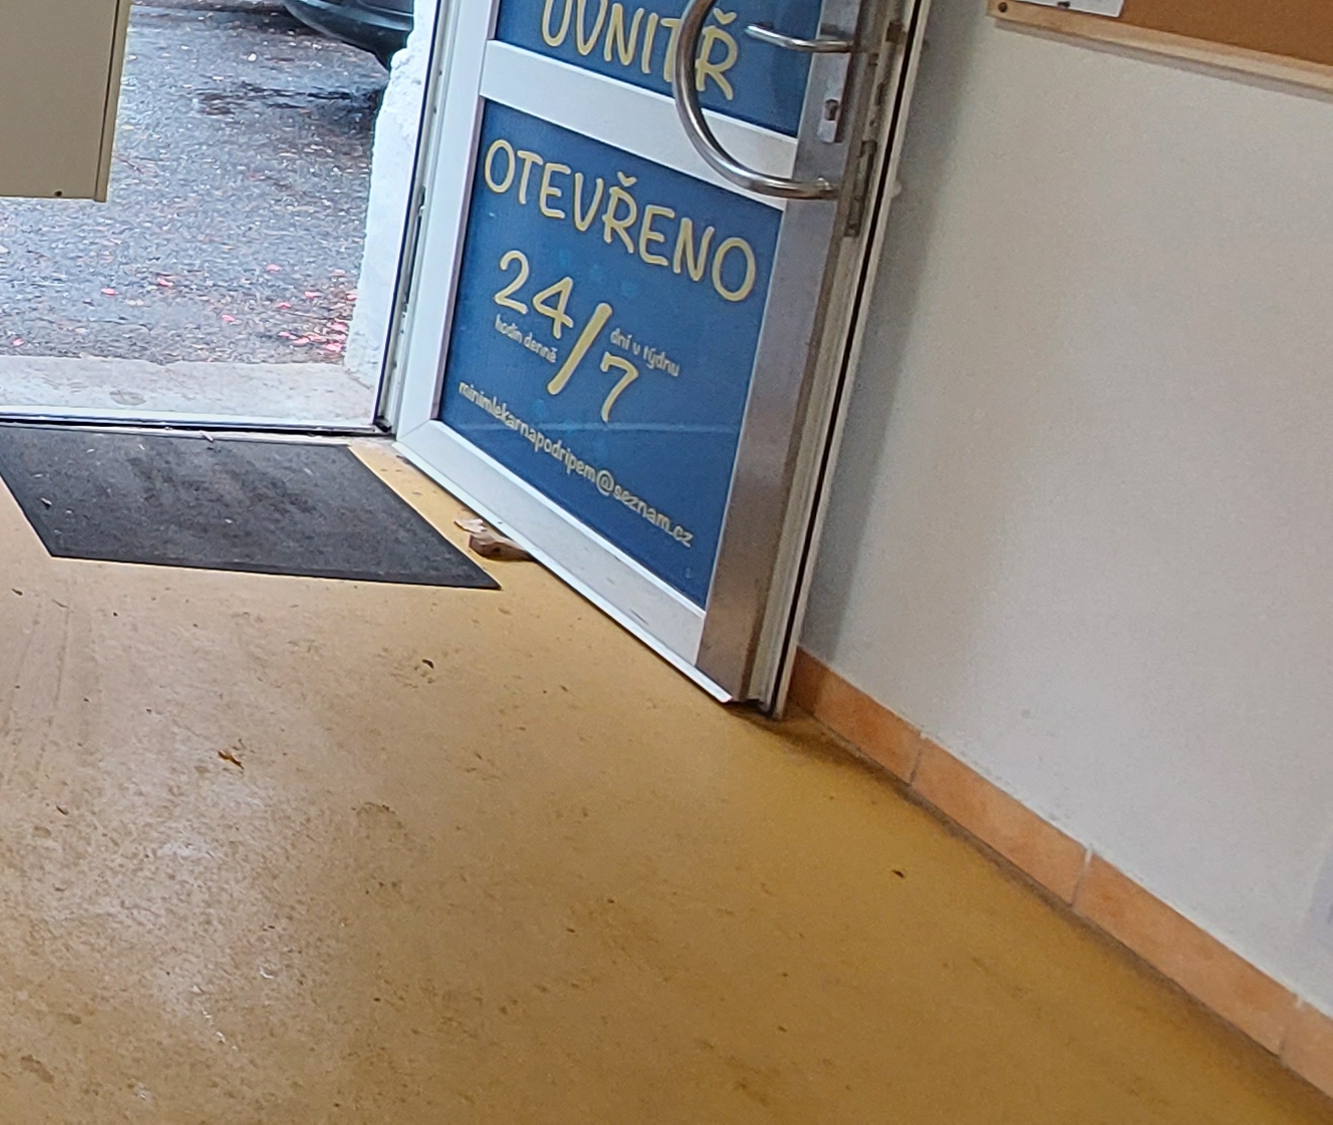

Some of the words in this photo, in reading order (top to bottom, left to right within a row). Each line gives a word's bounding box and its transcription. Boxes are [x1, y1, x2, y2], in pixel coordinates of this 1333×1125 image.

[484, 138, 756, 302] OTEVŘENO
[493, 250, 639, 423] 24/7
[495, 313, 523, 344] hodin
[523, 331, 558, 363] denně
[610, 328, 633, 351] dní
[633, 344, 641, 356] v
[643, 343, 680, 377] týdnu
[458, 382, 695, 549] minimlekarnapodripem@seznam.cz
